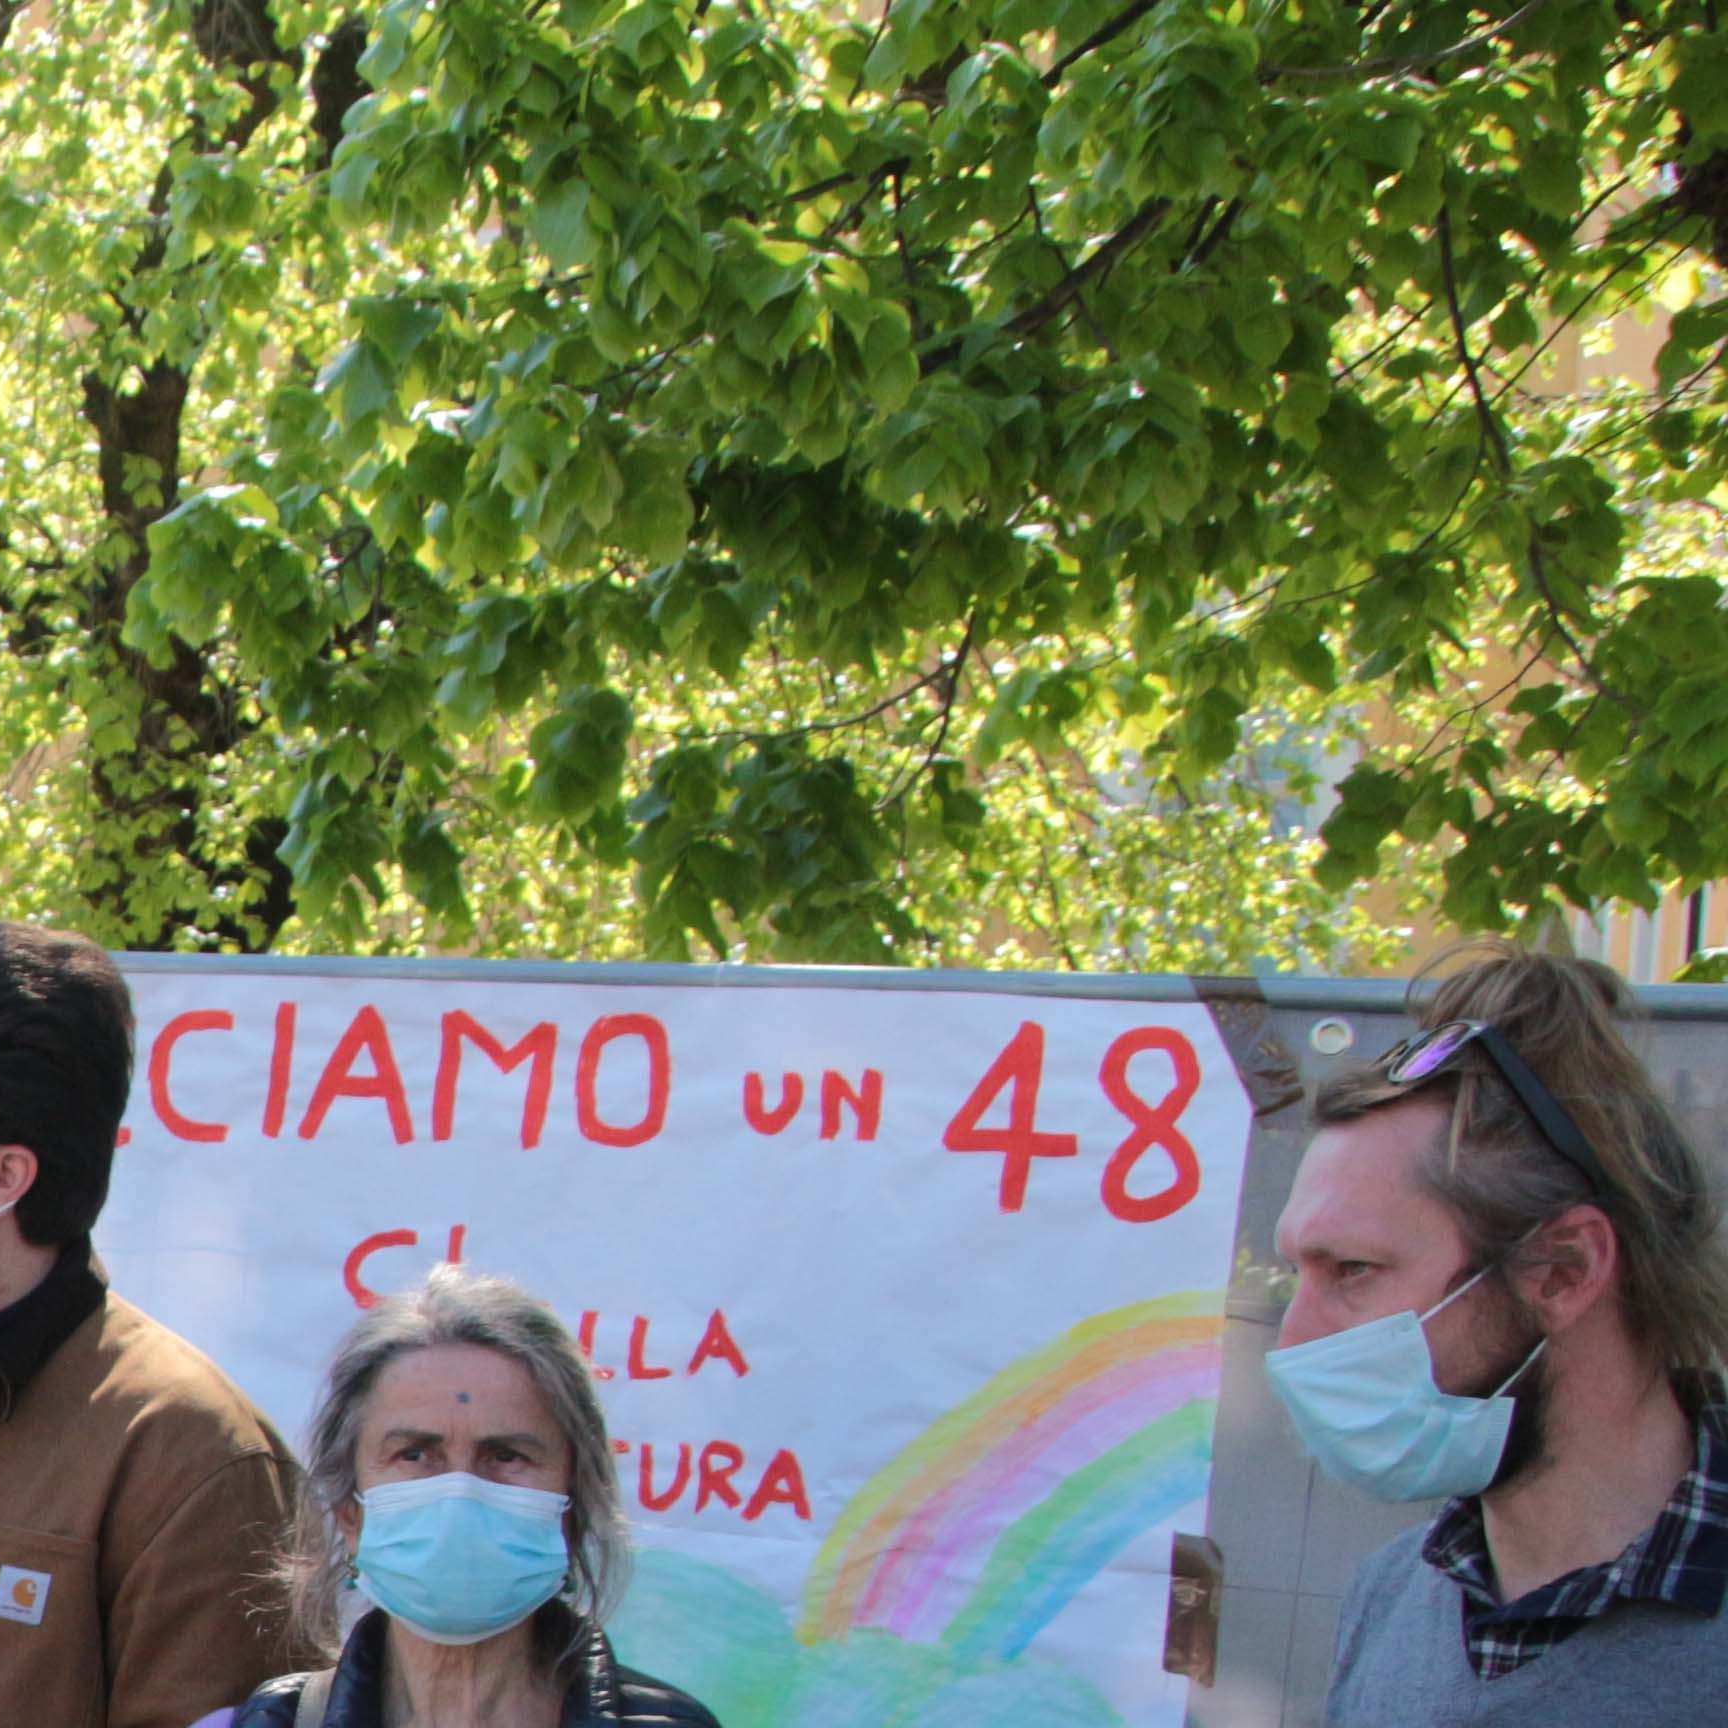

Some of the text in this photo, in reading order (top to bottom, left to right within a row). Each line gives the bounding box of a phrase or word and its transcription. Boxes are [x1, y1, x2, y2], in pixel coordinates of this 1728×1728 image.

[116, 1001, 1202, 1223] CIAMO UN 48
[577, 1309, 749, 1380] LLA
